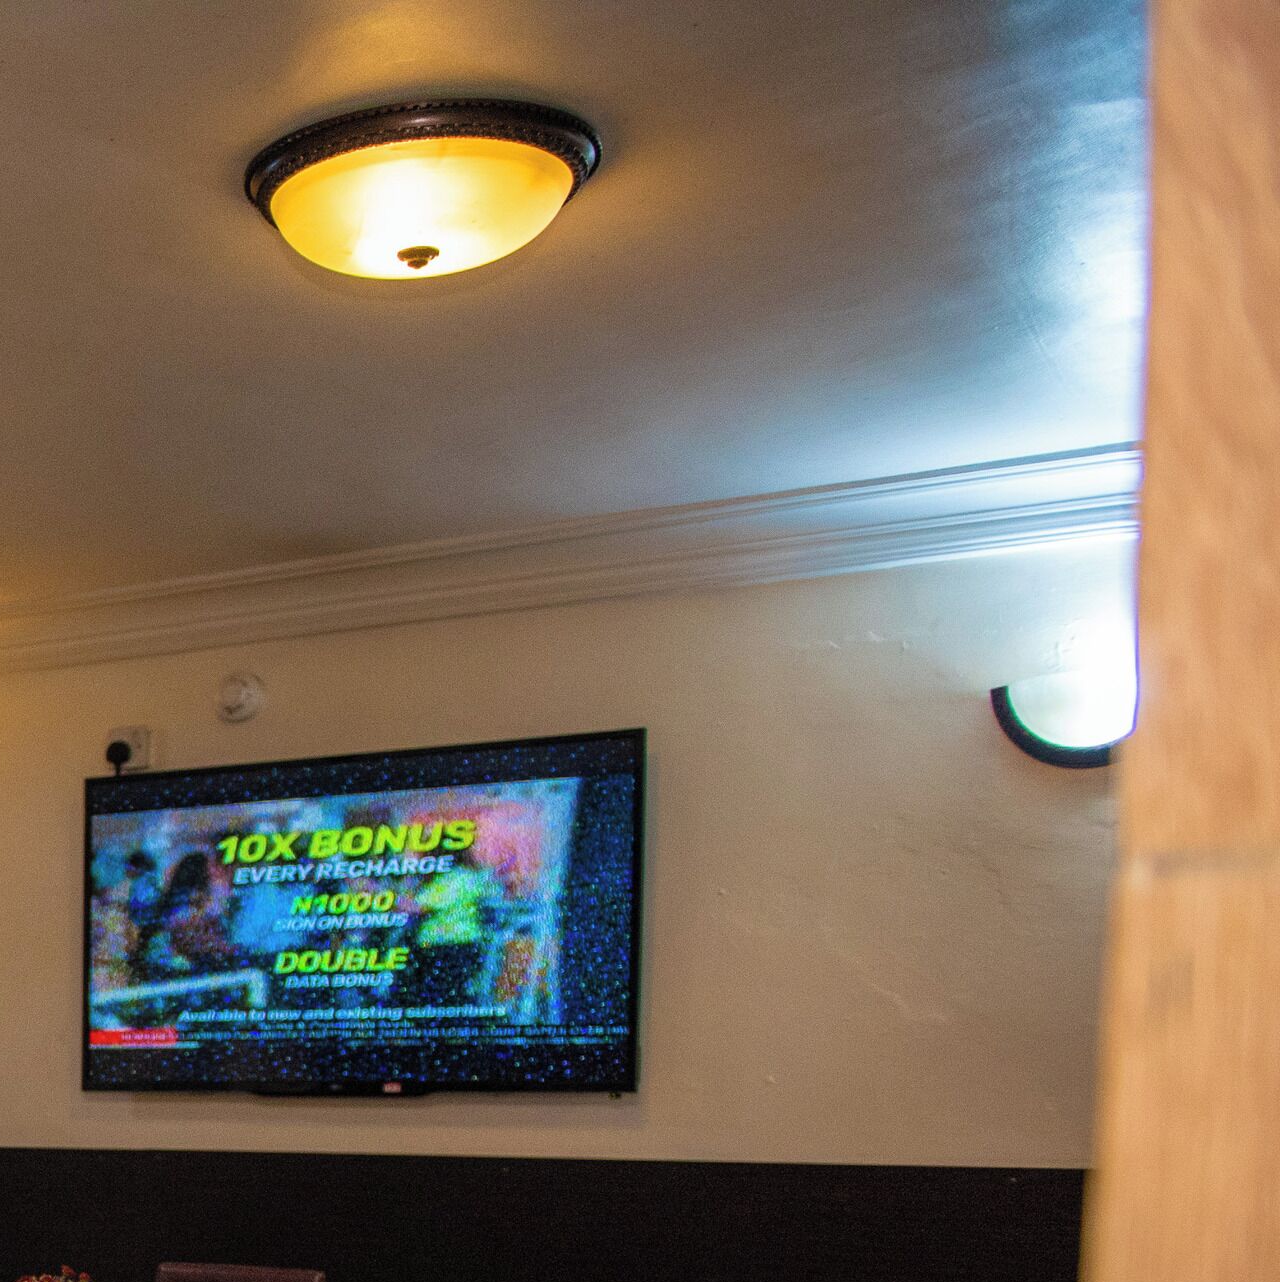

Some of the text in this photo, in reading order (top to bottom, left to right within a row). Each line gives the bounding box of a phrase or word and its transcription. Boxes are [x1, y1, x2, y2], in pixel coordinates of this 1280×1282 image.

[218, 819, 476, 865] 10X BONUS
[233, 854, 455, 885] EVERY RECHARGE
[317, 914, 344, 930] ON
[344, 912, 409, 930] BONUS
[274, 946, 410, 974] DOUBLE
[285, 971, 394, 988] DATA BONUS
